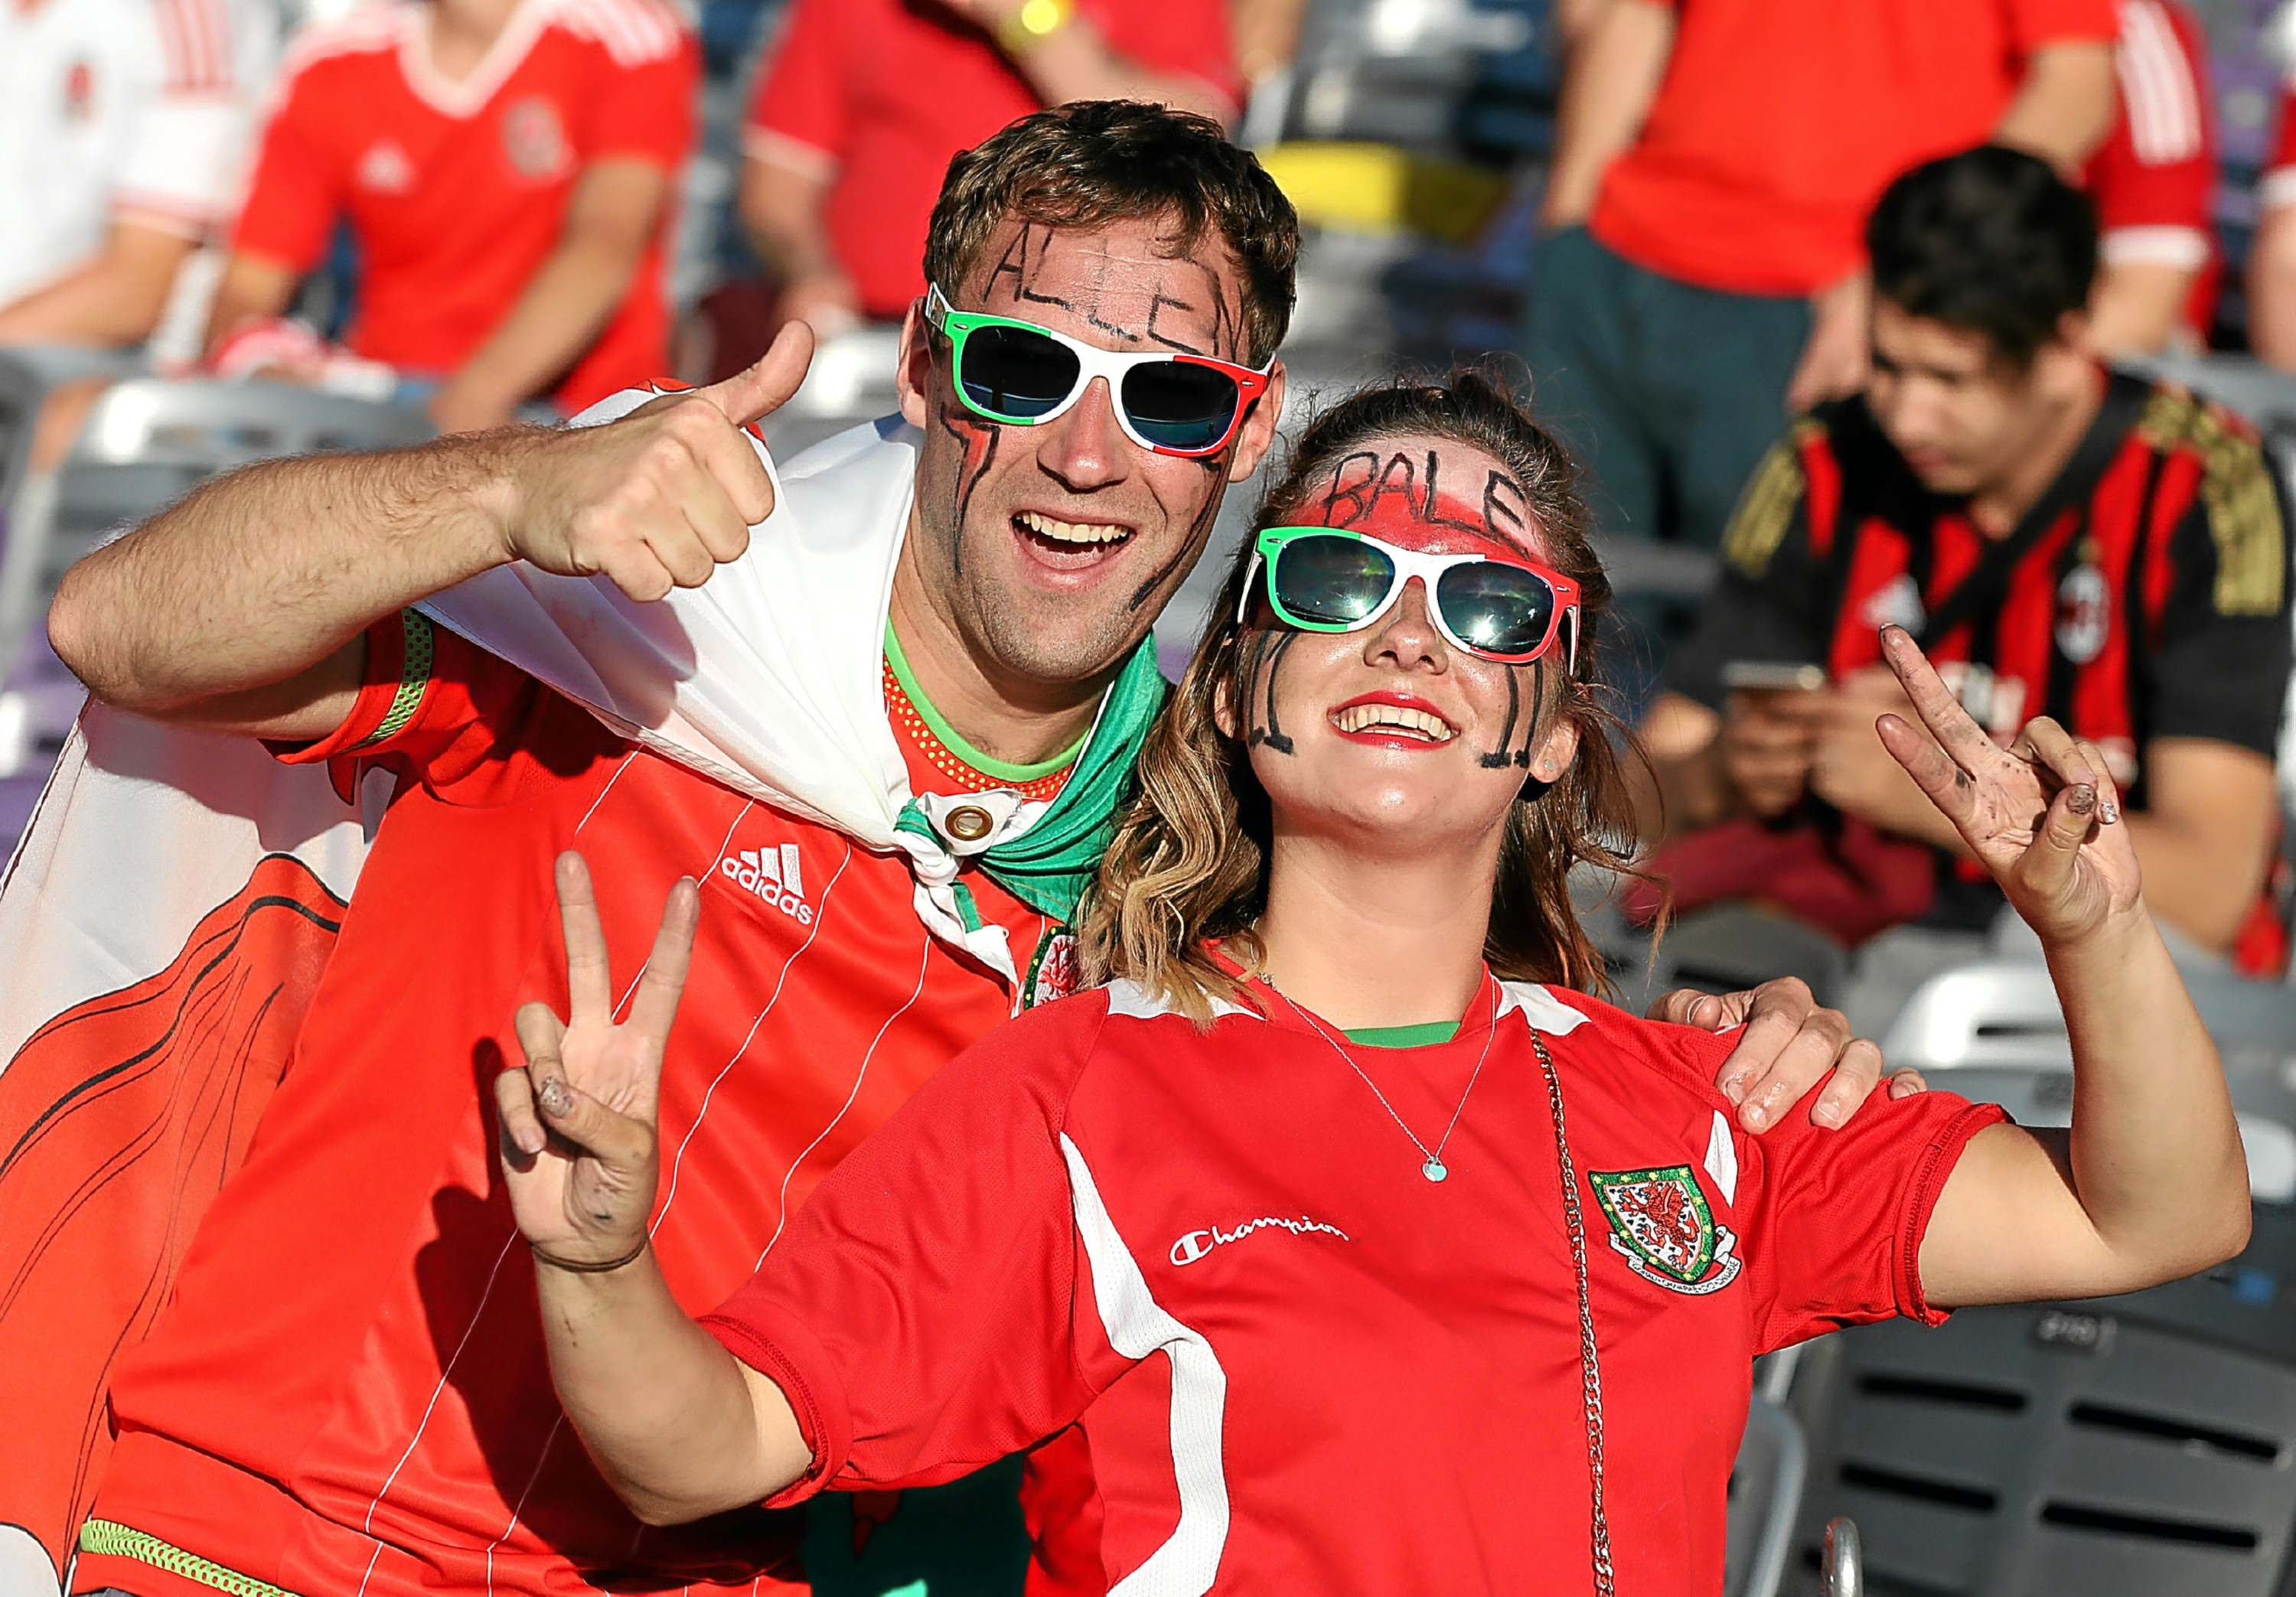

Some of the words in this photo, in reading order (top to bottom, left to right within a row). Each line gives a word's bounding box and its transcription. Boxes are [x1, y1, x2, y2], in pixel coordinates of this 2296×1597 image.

[1323, 449, 1531, 561] BALE
[721, 857, 814, 925] adidas
[1169, 1215, 1349, 1266] Champion
